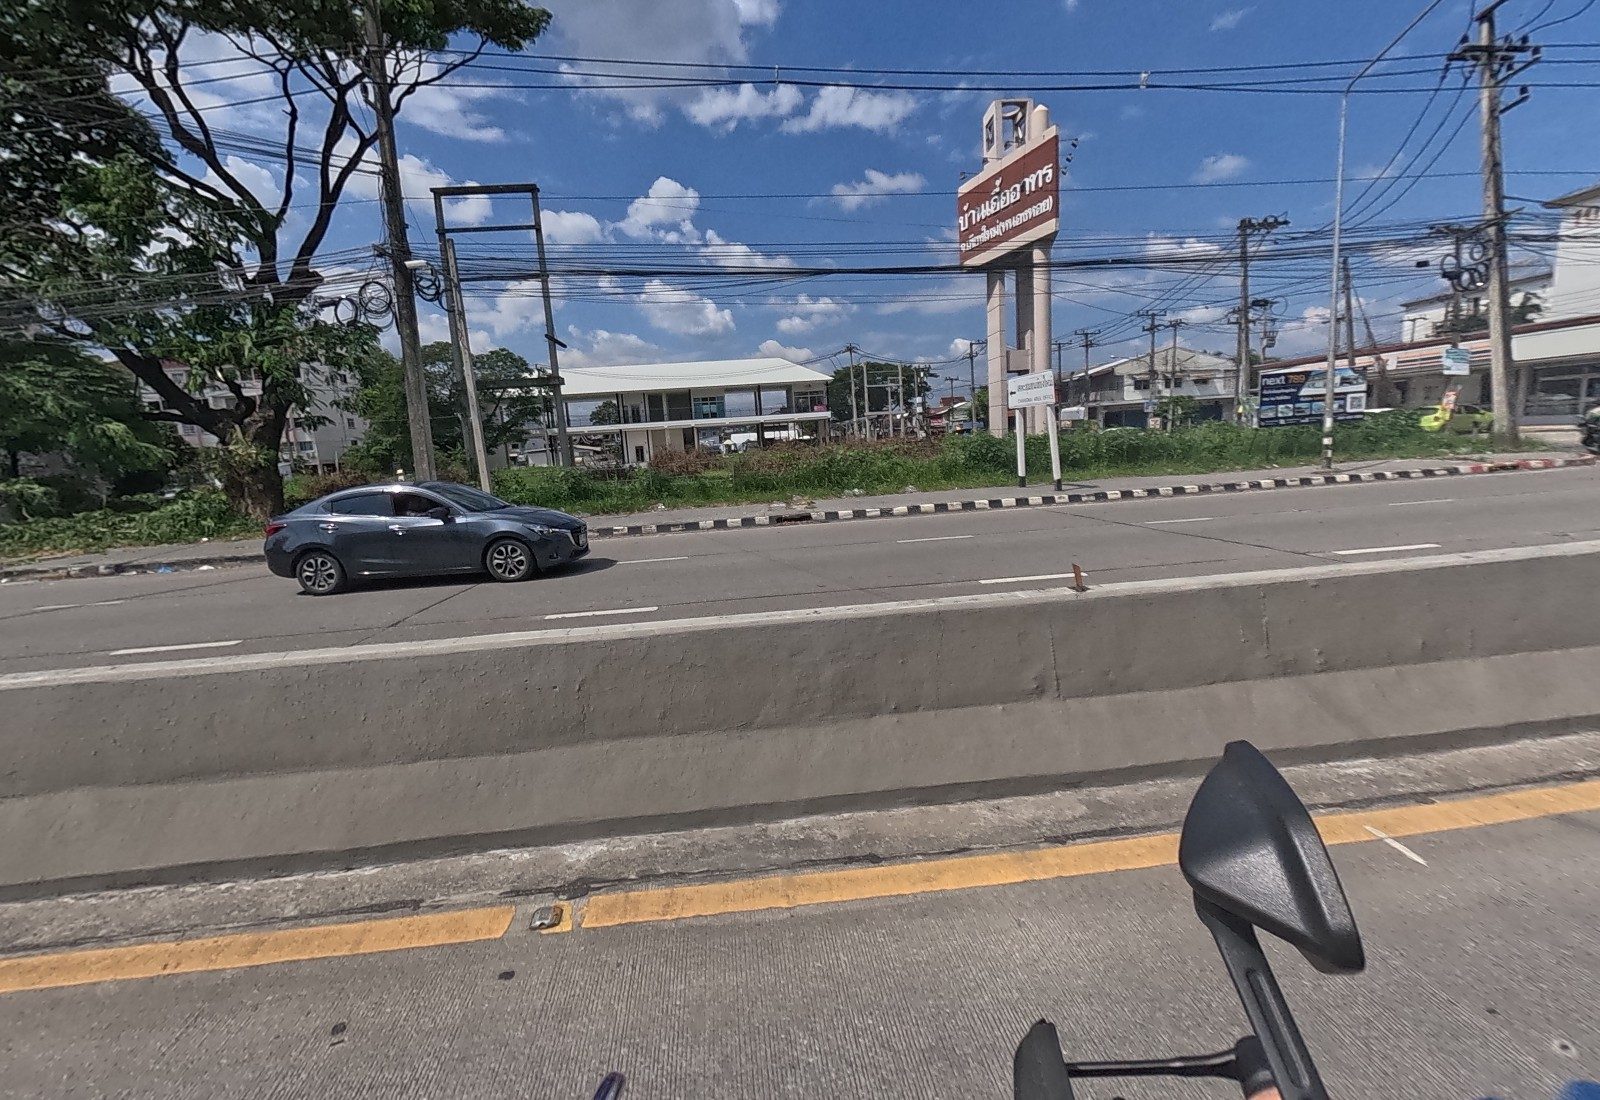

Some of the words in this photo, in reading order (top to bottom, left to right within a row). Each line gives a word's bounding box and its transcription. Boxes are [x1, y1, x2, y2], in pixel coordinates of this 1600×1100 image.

[959, 163, 1054, 231] บ้านเอื้ออาทร
[1261, 375, 1286, 386] next
